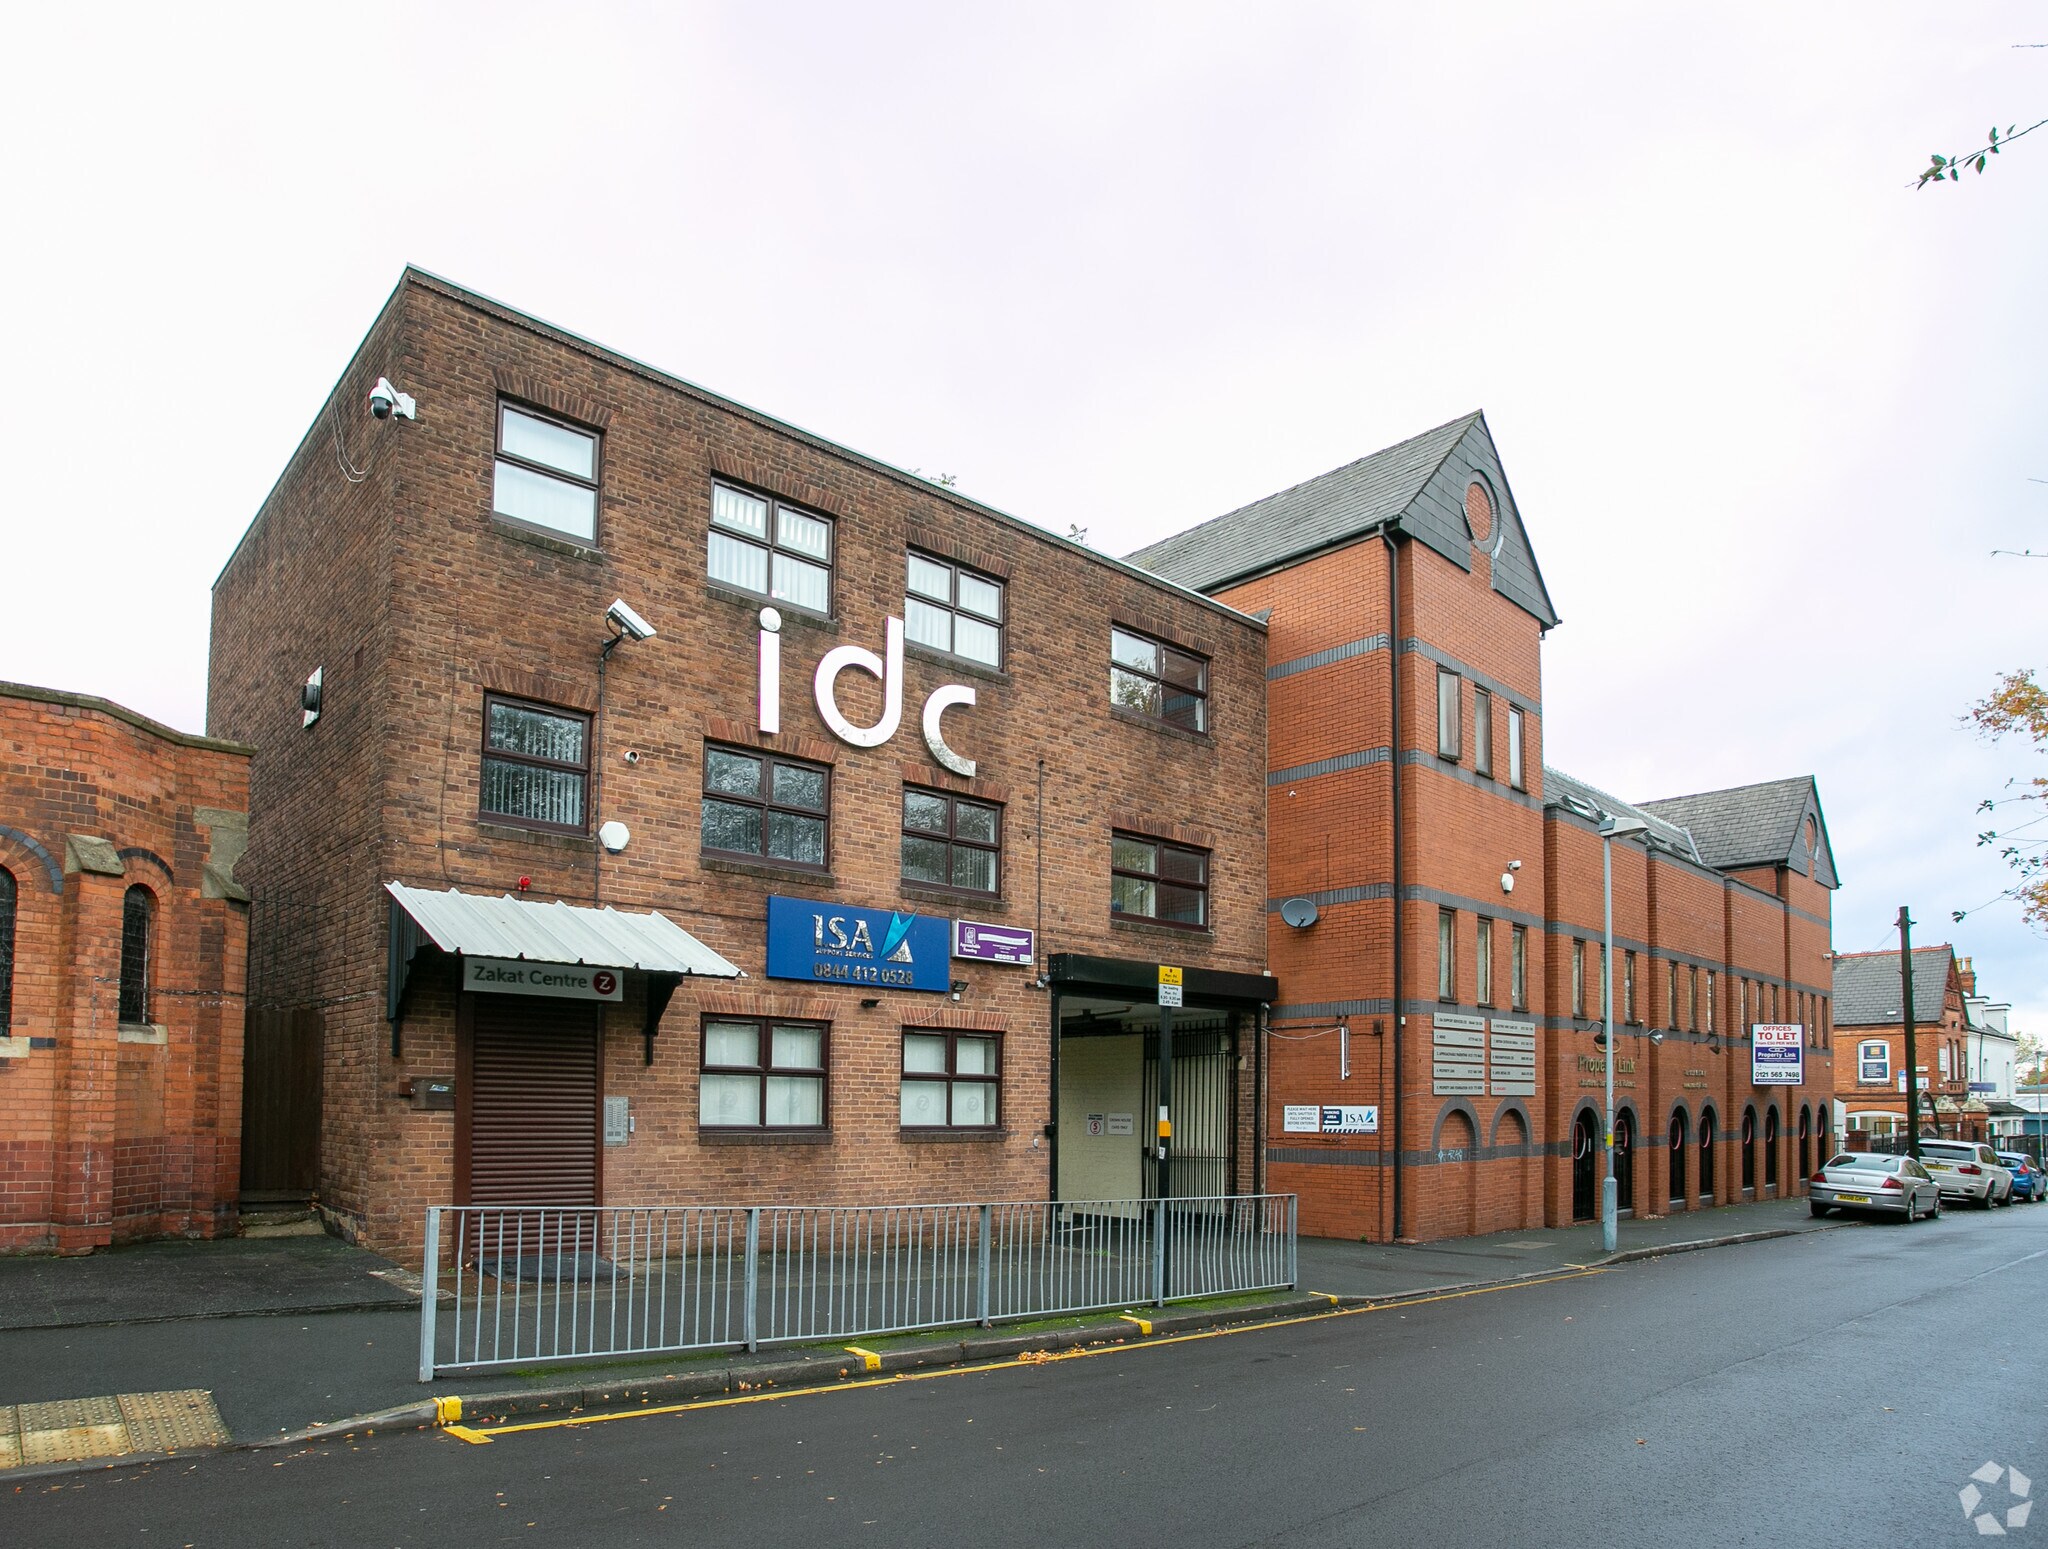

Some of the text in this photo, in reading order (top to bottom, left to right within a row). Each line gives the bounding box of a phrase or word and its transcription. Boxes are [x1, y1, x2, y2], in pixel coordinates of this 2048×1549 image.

[758, 606, 976, 777] idc
[473, 965, 524, 984] Zakat
[529, 970, 588, 988] Centre
[813, 962, 914, 985] 0844 412 0528
[1757, 1032, 1797, 1040] TO LET
[1757, 1051, 1783, 1059] Property
[1617, 1057, 1636, 1073] Link
[1345, 1113, 1364, 1123] ISA
